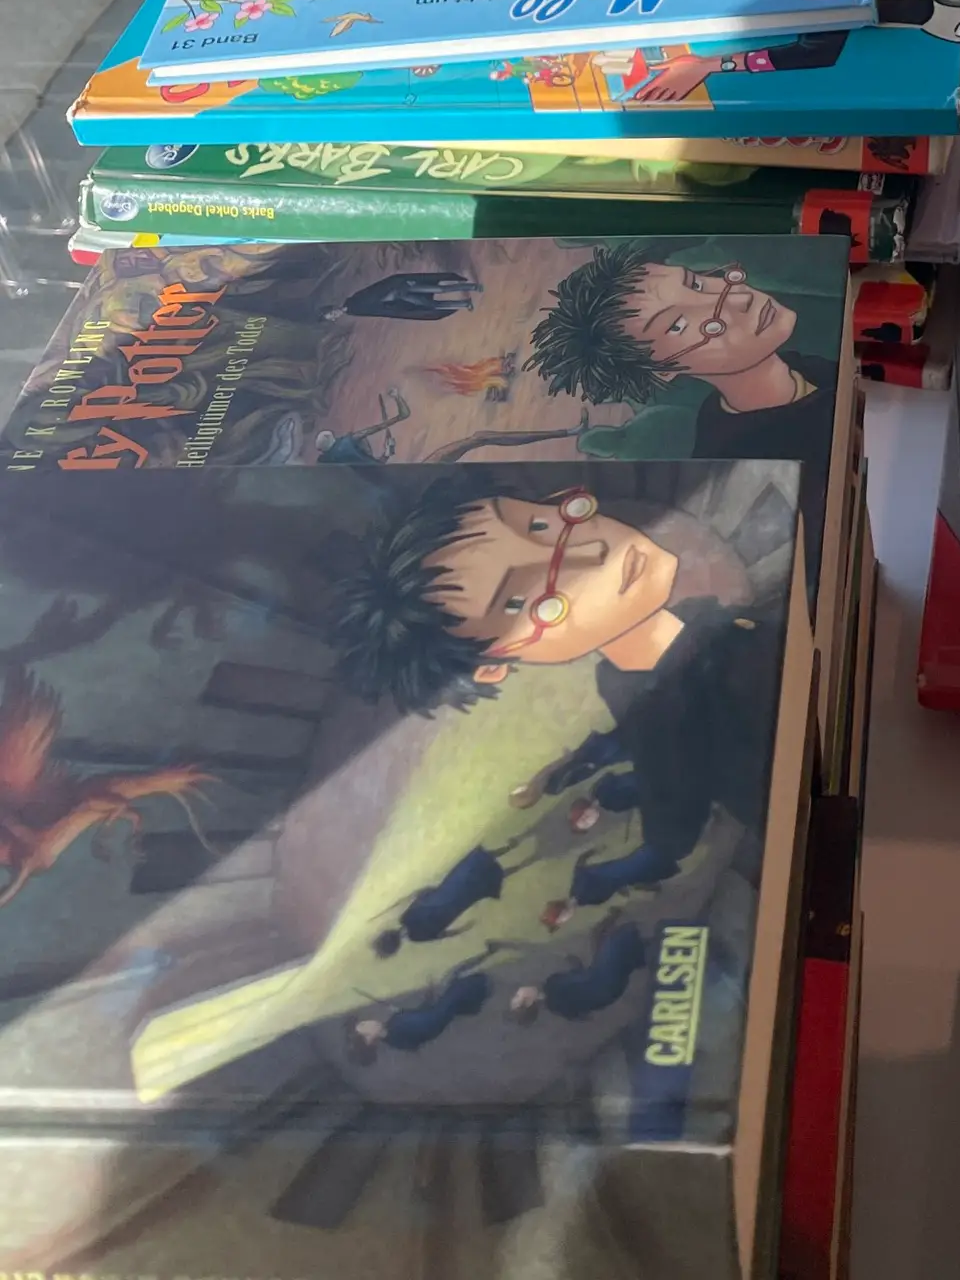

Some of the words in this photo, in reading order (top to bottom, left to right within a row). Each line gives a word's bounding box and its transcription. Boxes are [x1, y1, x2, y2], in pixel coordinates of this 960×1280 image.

[170, 37, 197, 51] 31
[202, 31, 259, 49] Band
[225, 142, 392, 185] BARKS
[403, 148, 524, 181] CARL
[147, 201, 203, 217] Dagobert
[205, 204, 240, 218] Onkel
[242, 205, 275, 220] Barks
[68, 283, 227, 421] Potter
[227, 316, 268, 355] Todes
[41, 320, 111, 408] ROWLING
[226, 355, 250, 384] des
[176, 384, 237, 469] Heiligtümer
[646, 925, 705, 1067] CARLSEN
